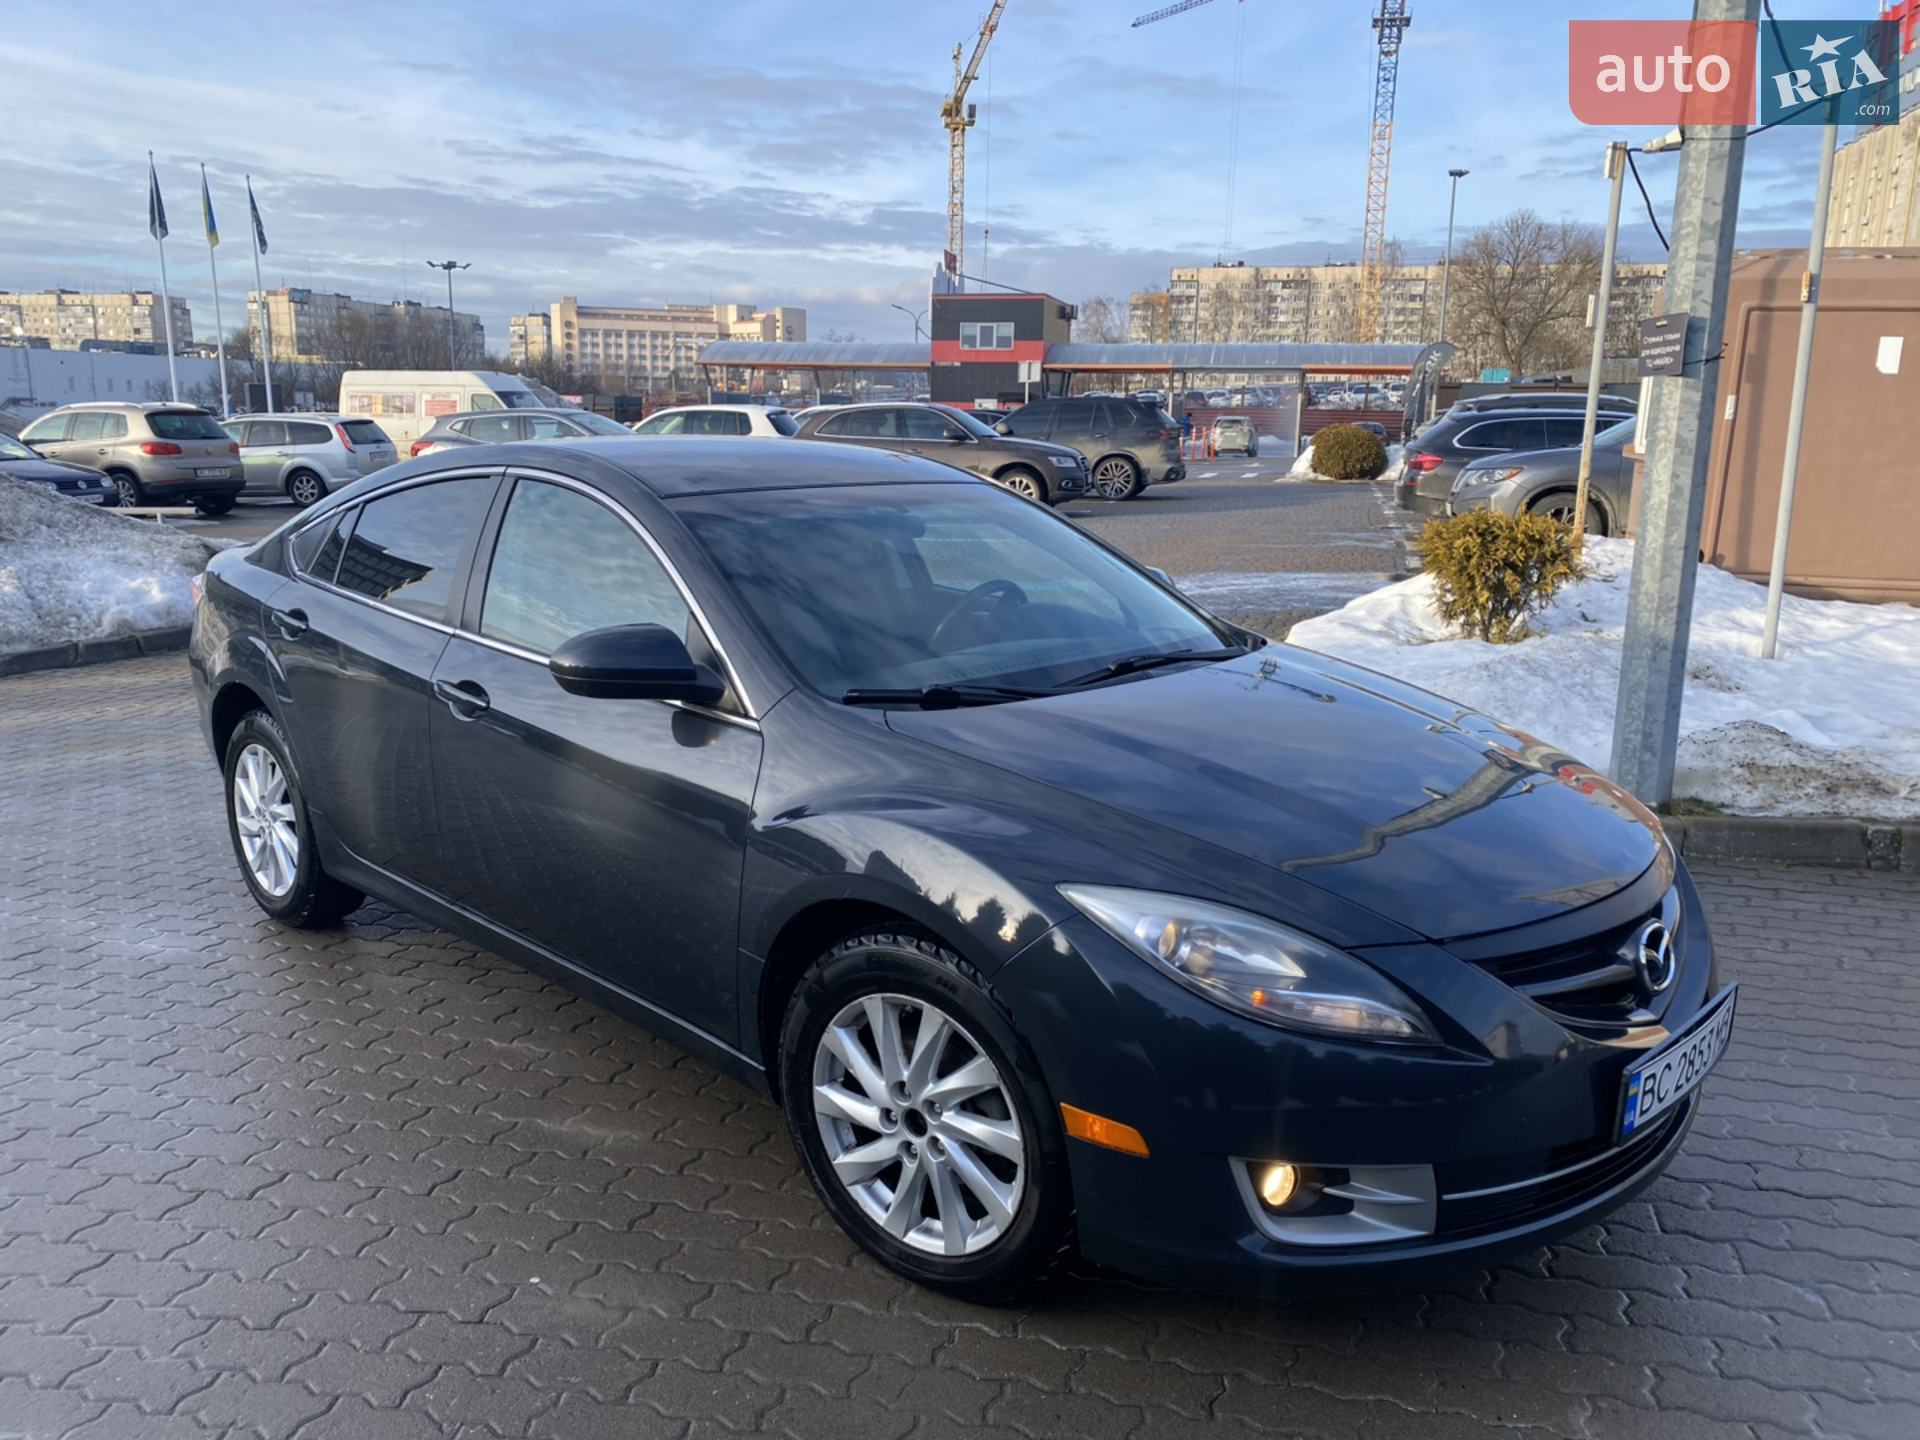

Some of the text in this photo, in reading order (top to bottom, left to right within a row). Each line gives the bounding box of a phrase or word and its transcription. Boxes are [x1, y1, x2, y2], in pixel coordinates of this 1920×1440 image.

[1643, 332, 1681, 345] Стоянка тільки
[1641, 343, 1681, 357] для відвідувачів
[1638, 1062, 1672, 1118] BC
[1673, 1026, 1715, 1094] 2853
